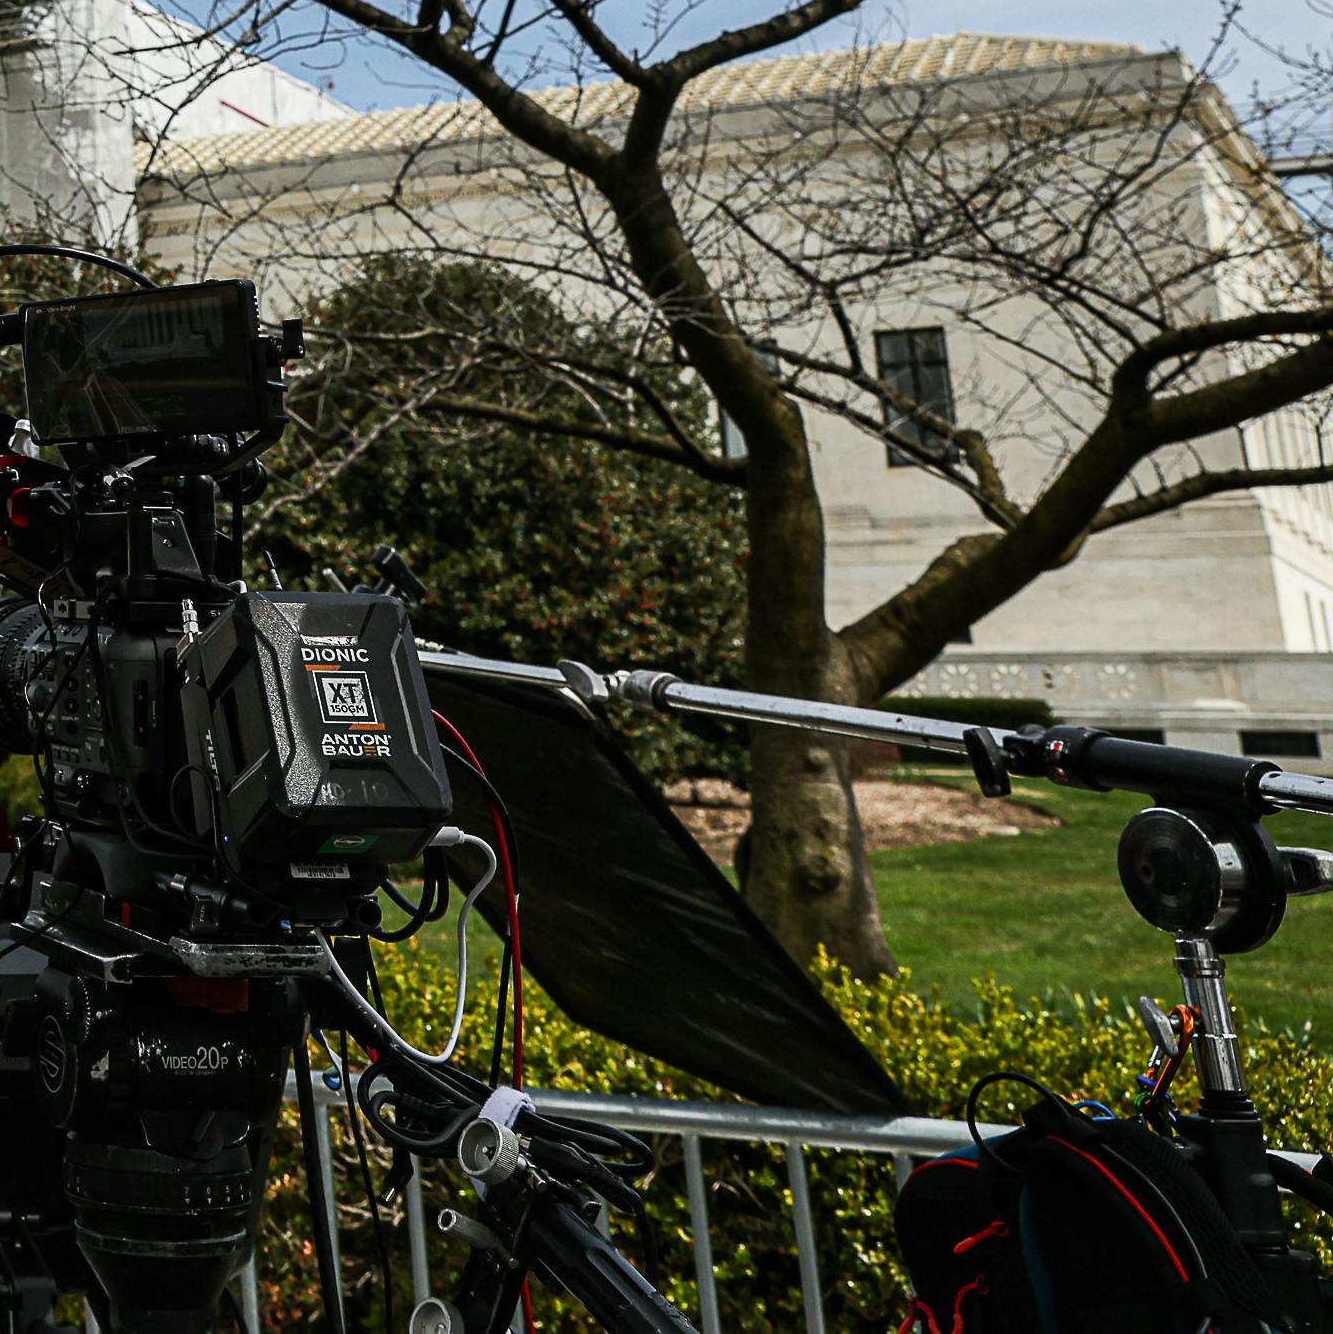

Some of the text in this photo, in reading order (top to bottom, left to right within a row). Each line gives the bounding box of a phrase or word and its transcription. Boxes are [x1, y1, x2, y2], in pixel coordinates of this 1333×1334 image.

[300, 647, 370, 663] DIONIC
[327, 682, 358, 705] XT
[330, 704, 365, 715] 150GM
[321, 733, 390, 746] ANTON
[321, 745, 392, 758] BAUER
